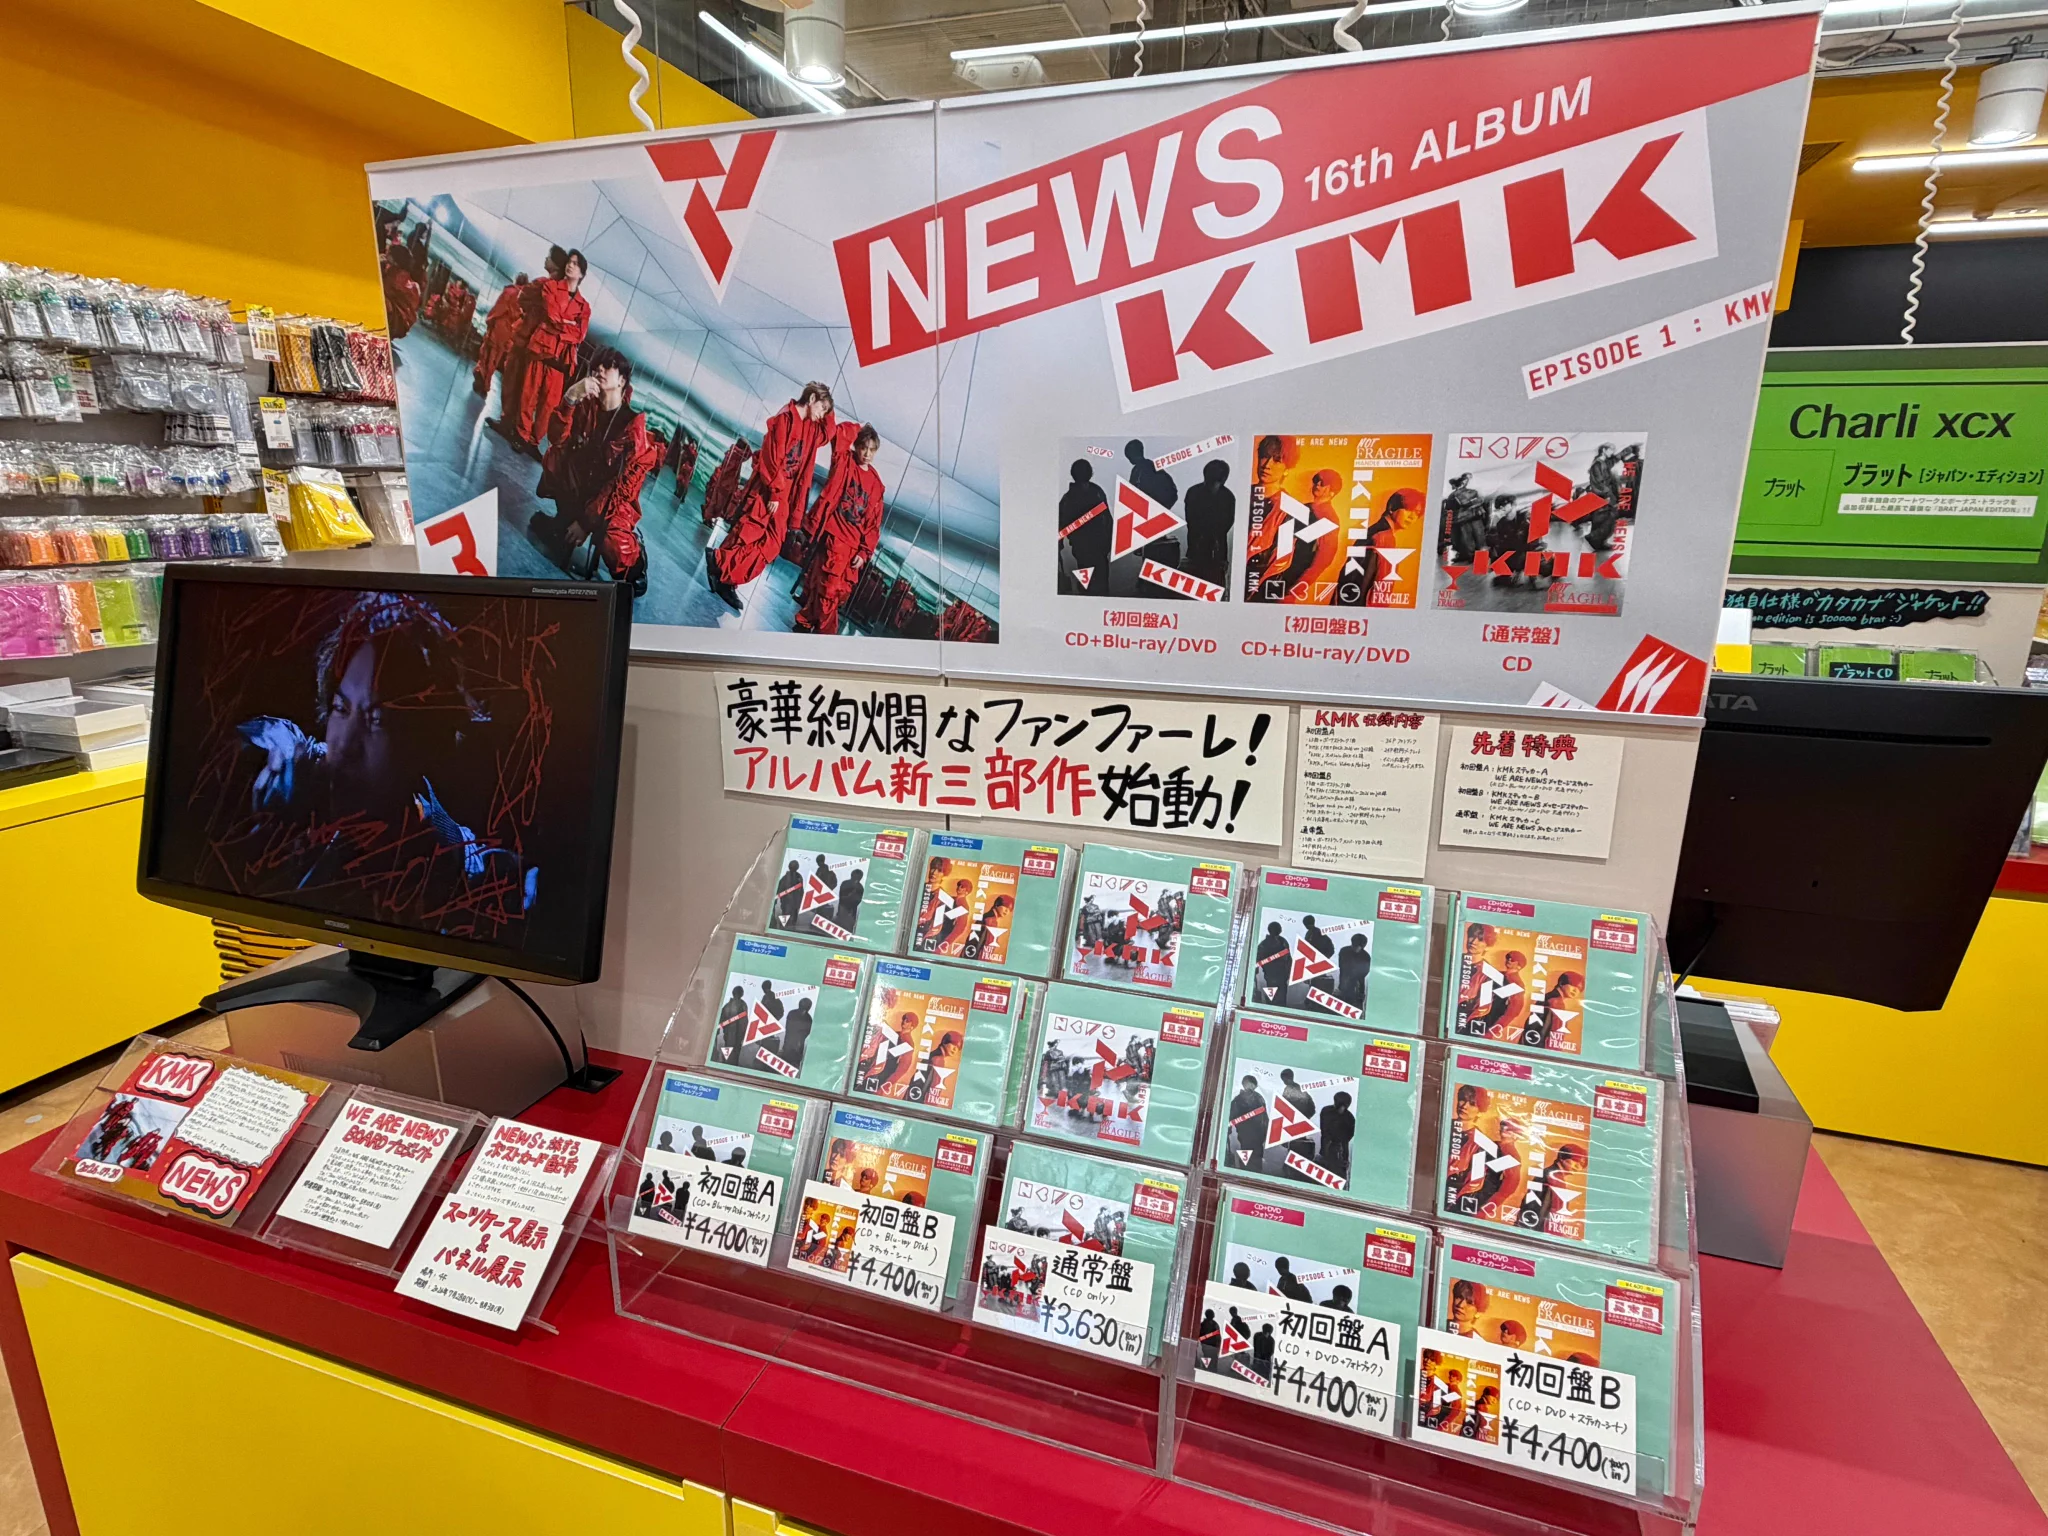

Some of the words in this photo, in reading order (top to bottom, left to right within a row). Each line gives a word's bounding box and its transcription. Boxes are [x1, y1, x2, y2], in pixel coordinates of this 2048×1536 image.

[868, 105, 1284, 350] NEWS
[1304, 147, 1394, 202] 16th
[1410, 76, 1593, 171] ALBUM
[1115, 131, 1697, 393] KMK
[1528, 335, 1643, 392] EPISODE
[1661, 324, 1677, 349] 1
[1789, 403, 1920, 439] Charli
[1932, 412, 2016, 438] xcx
[1155, 448, 1192, 469] EPISODE
[1216, 434, 1233, 446] KMK
[1296, 438, 1305, 446] WE
[1310, 438, 1324, 446] ARE
[1329, 438, 1348, 446] NEWS
[1356, 448, 1422, 459] FRAGILE
[1357, 438, 1380, 448] NOT
[1844, 462, 1913, 488] ブラット
[1618, 487, 1633, 511] ARE
[1763, 478, 1806, 498] ブラット
[1251, 486, 1265, 537] EPISODE
[1344, 470, 1373, 576] KMK
[1611, 519, 1628, 552] NEWS
[1472, 550, 1624, 579] KMK
[1141, 562, 1222, 601] KMK
[1248, 572, 1260, 592] KMK
[1374, 581, 1393, 592] NOT
[1372, 593, 1410, 604] FRAGILE
[1102, 610, 1179, 630] 【初回盤A】
[1284, 615, 1369, 637] 【初回盤B】
[1765, 612, 1802, 624] edition
[1805, 614, 1815, 624] is
[1860, 613, 1886, 625] brat
[1065, 631, 1217, 654] CD+Blu-ray/DVD
[1482, 623, 1560, 646] 【通常盤】
[1240, 640, 1410, 664] CD+Blu-ray/DVD
[1502, 656, 1532, 672] CD
[1833, 667, 1893, 679] ブラットCD
[1314, 710, 1360, 728] KMK
[1471, 730, 1578, 761] 先着特典
[733, 745, 1252, 834] アルバム新三部作始動!
[1525, 776, 1547, 784] NEWS
[1520, 800, 1541, 808] NEWS
[981, 869, 1015, 880] FRAGILE
[1093, 940, 1175, 967] KMK
[1536, 940, 1582, 954] FRAGILE
[1461, 954, 1473, 990] EPISODE
[928, 1003, 965, 1014] FRAGILE
[1309, 988, 1360, 1019] KMK
[1549, 1031, 1563, 1041] NOT
[1549, 1040, 1577, 1051] FRAGILE
[143, 1060, 209, 1091] KMK
[758, 1048, 798, 1078] KMK
[927, 1095, 949, 1107] FRAGILE
[1056, 1090, 1145, 1122] KMK
[342, 1125, 388, 1150] BOARD
[346, 1104, 374, 1124] WE
[370, 1113, 404, 1134] ARE
[401, 1120, 449, 1147] NEWS
[1451, 1121, 1463, 1160] EPISODE
[889, 1158, 928, 1173] FRAGILE
[1287, 1152, 1345, 1190] KMK
[166, 1161, 242, 1208] NEWS
[697, 1165, 775, 1206] 初回盤A
[859, 1198, 938, 1240] 初回盤B
[1253, 1202, 1282, 1214] CD+DVD
[442, 1202, 549, 1251] スーツケース展示
[685, 1211, 748, 1253] ¥4,400
[1548, 1221, 1579, 1237] FRAGILE
[476, 1233, 491, 1253] &
[913, 1241, 929, 1251] Disk
[434, 1247, 527, 1289] パネル展示
[1476, 1249, 1509, 1263] CD+DVD
[848, 1250, 916, 1297] ¥4,400
[1051, 1250, 1134, 1292] 通常盤
[1297, 1271, 1326, 1283] EPISODE
[1087, 1293, 1116, 1305] only)
[1497, 1289, 1511, 1299] ARE
[1513, 1293, 1531, 1304] NEWS
[1040, 1295, 1117, 1347] ¥3,630
[1278, 1302, 1390, 1360] 初回盤A
[1537, 1308, 1595, 1330] FRAGILE
[1273, 1358, 1357, 1418] ¥4,400
[1505, 1352, 1621, 1411] 初回盤B
[1502, 1415, 1602, 1472] ¥4,400
